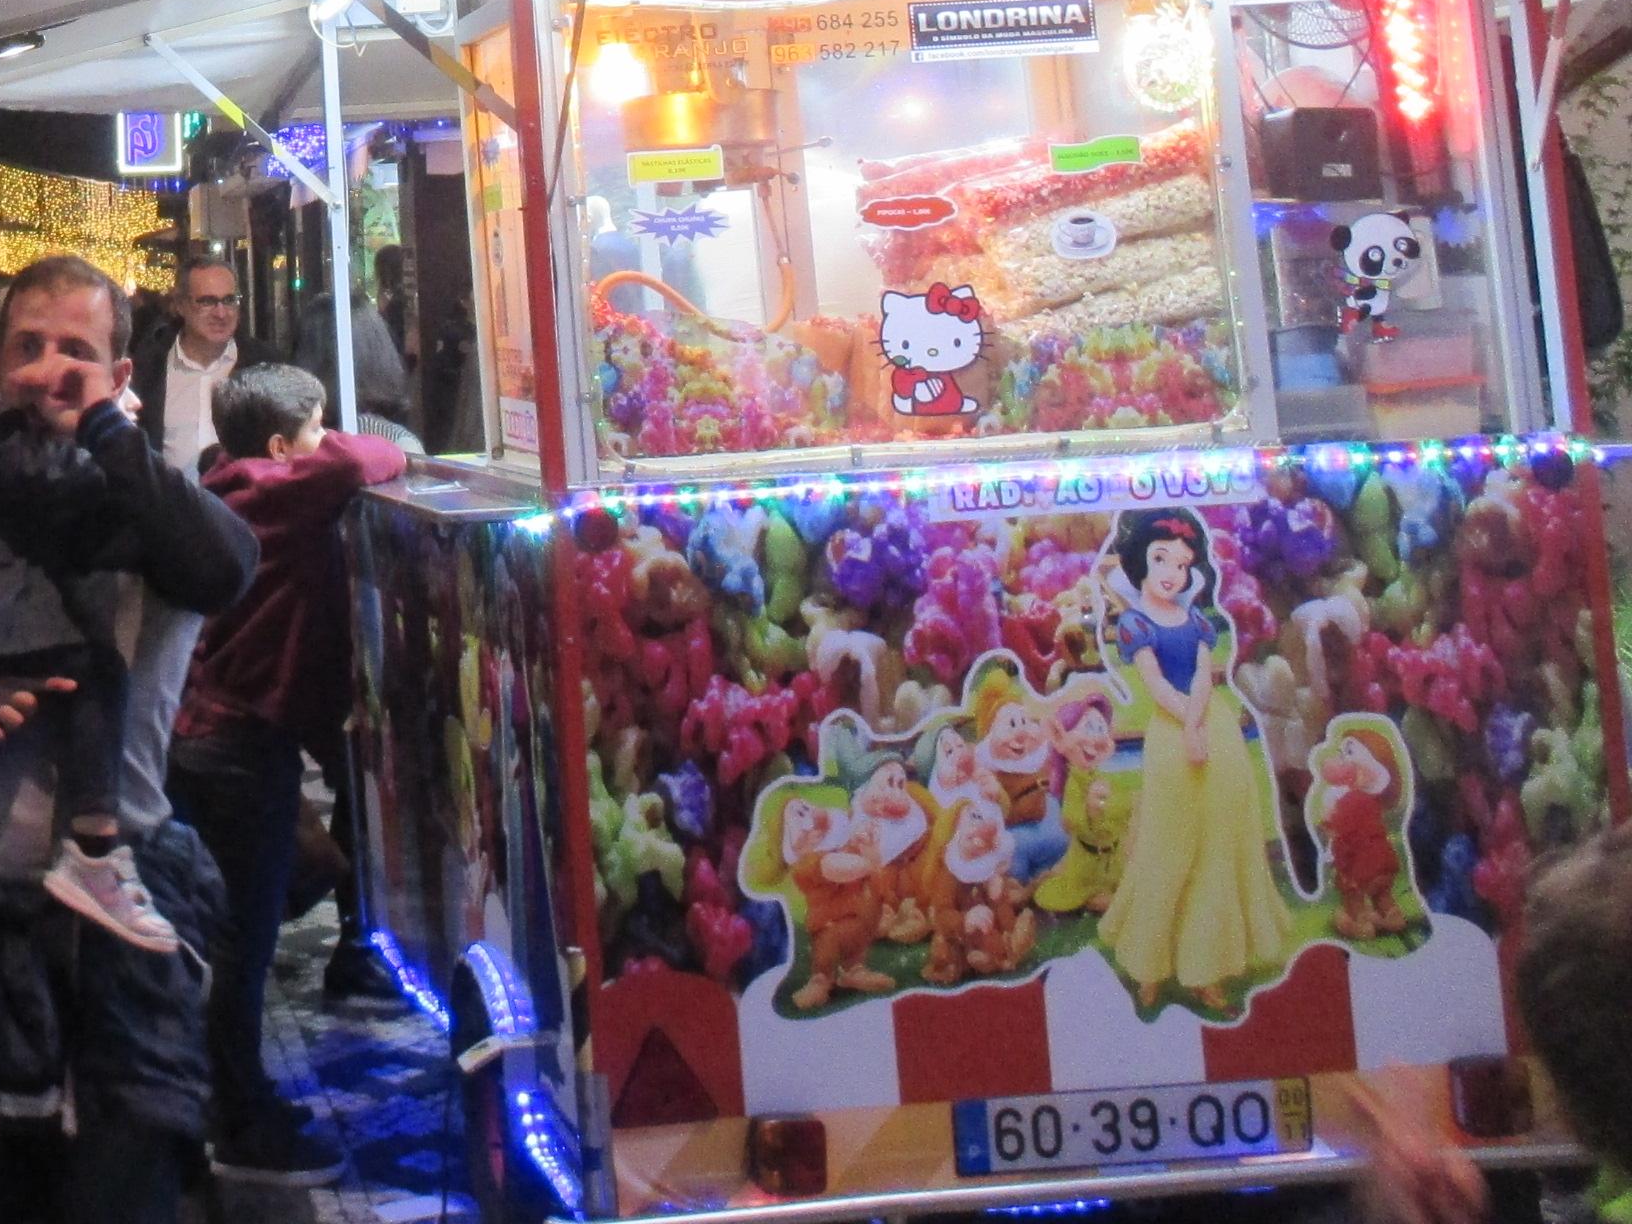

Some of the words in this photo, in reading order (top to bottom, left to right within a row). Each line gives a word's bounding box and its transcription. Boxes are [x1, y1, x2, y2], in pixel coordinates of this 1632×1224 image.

[816, 13, 854, 30] 684
[861, 10, 899, 28] 255
[917, 4, 1087, 33] LONDRINA
[819, 42, 857, 61] 582
[863, 39, 900, 58] 217
